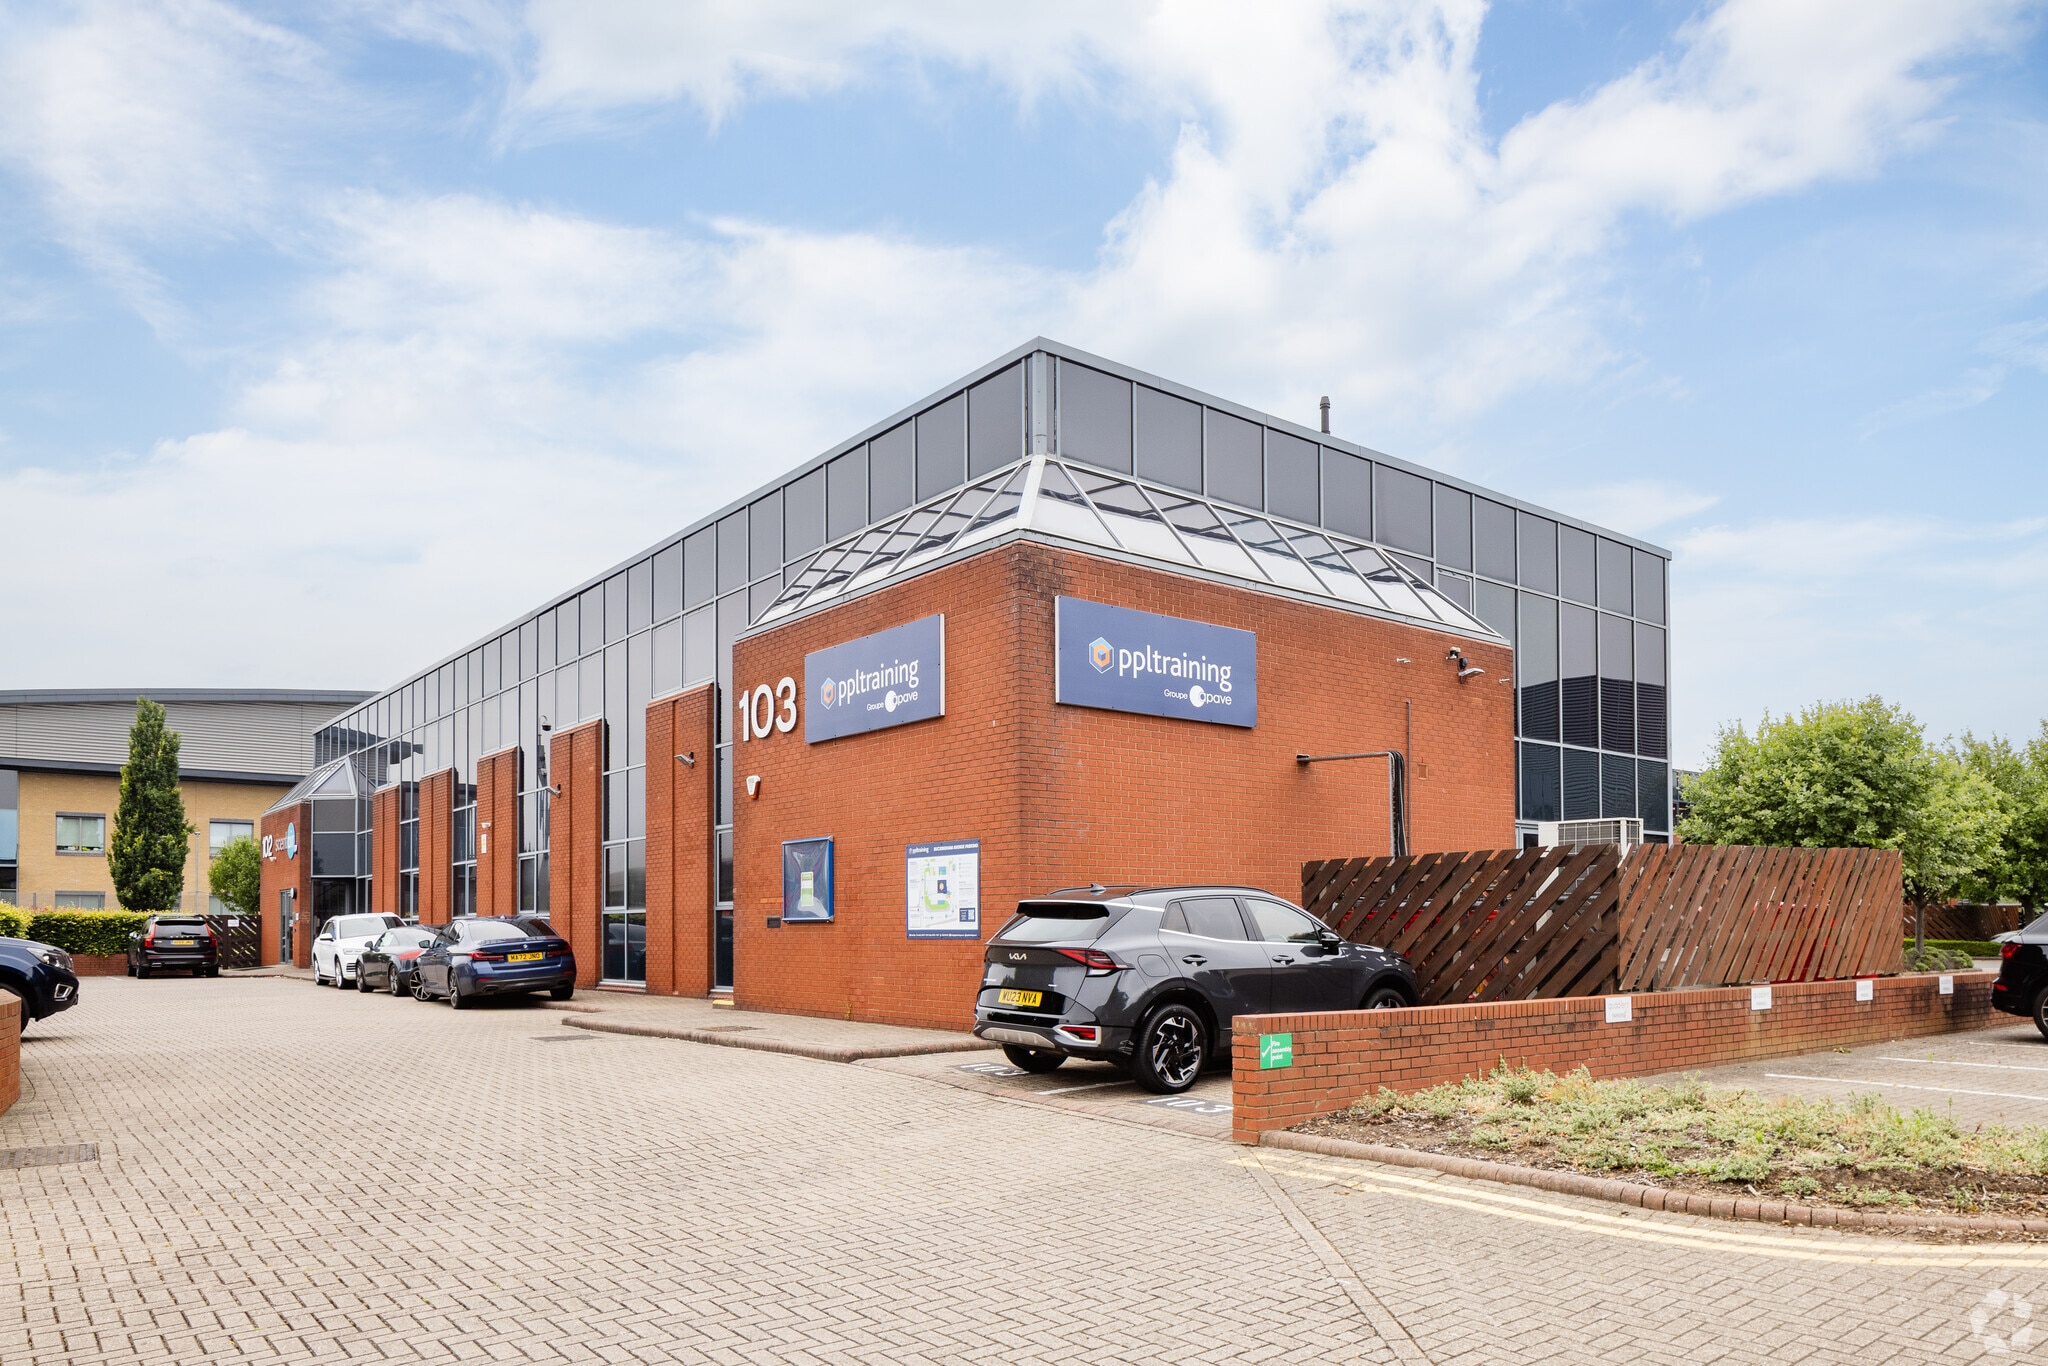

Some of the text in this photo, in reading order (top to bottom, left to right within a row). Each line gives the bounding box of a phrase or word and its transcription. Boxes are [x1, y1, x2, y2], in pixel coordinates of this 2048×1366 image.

[1119, 645, 1232, 692] ppltraining
[838, 659, 919, 707] ppltraining
[866, 690, 918, 711] Groupe apave
[1164, 688, 1232, 706] Groupe apave
[738, 676, 797, 742] 103
[262, 835, 273, 858] 102
[1002, 990, 1037, 1005] WU23 NVA
[960, 1063, 1029, 1077] 103
[1147, 1097, 1234, 1114] 103
